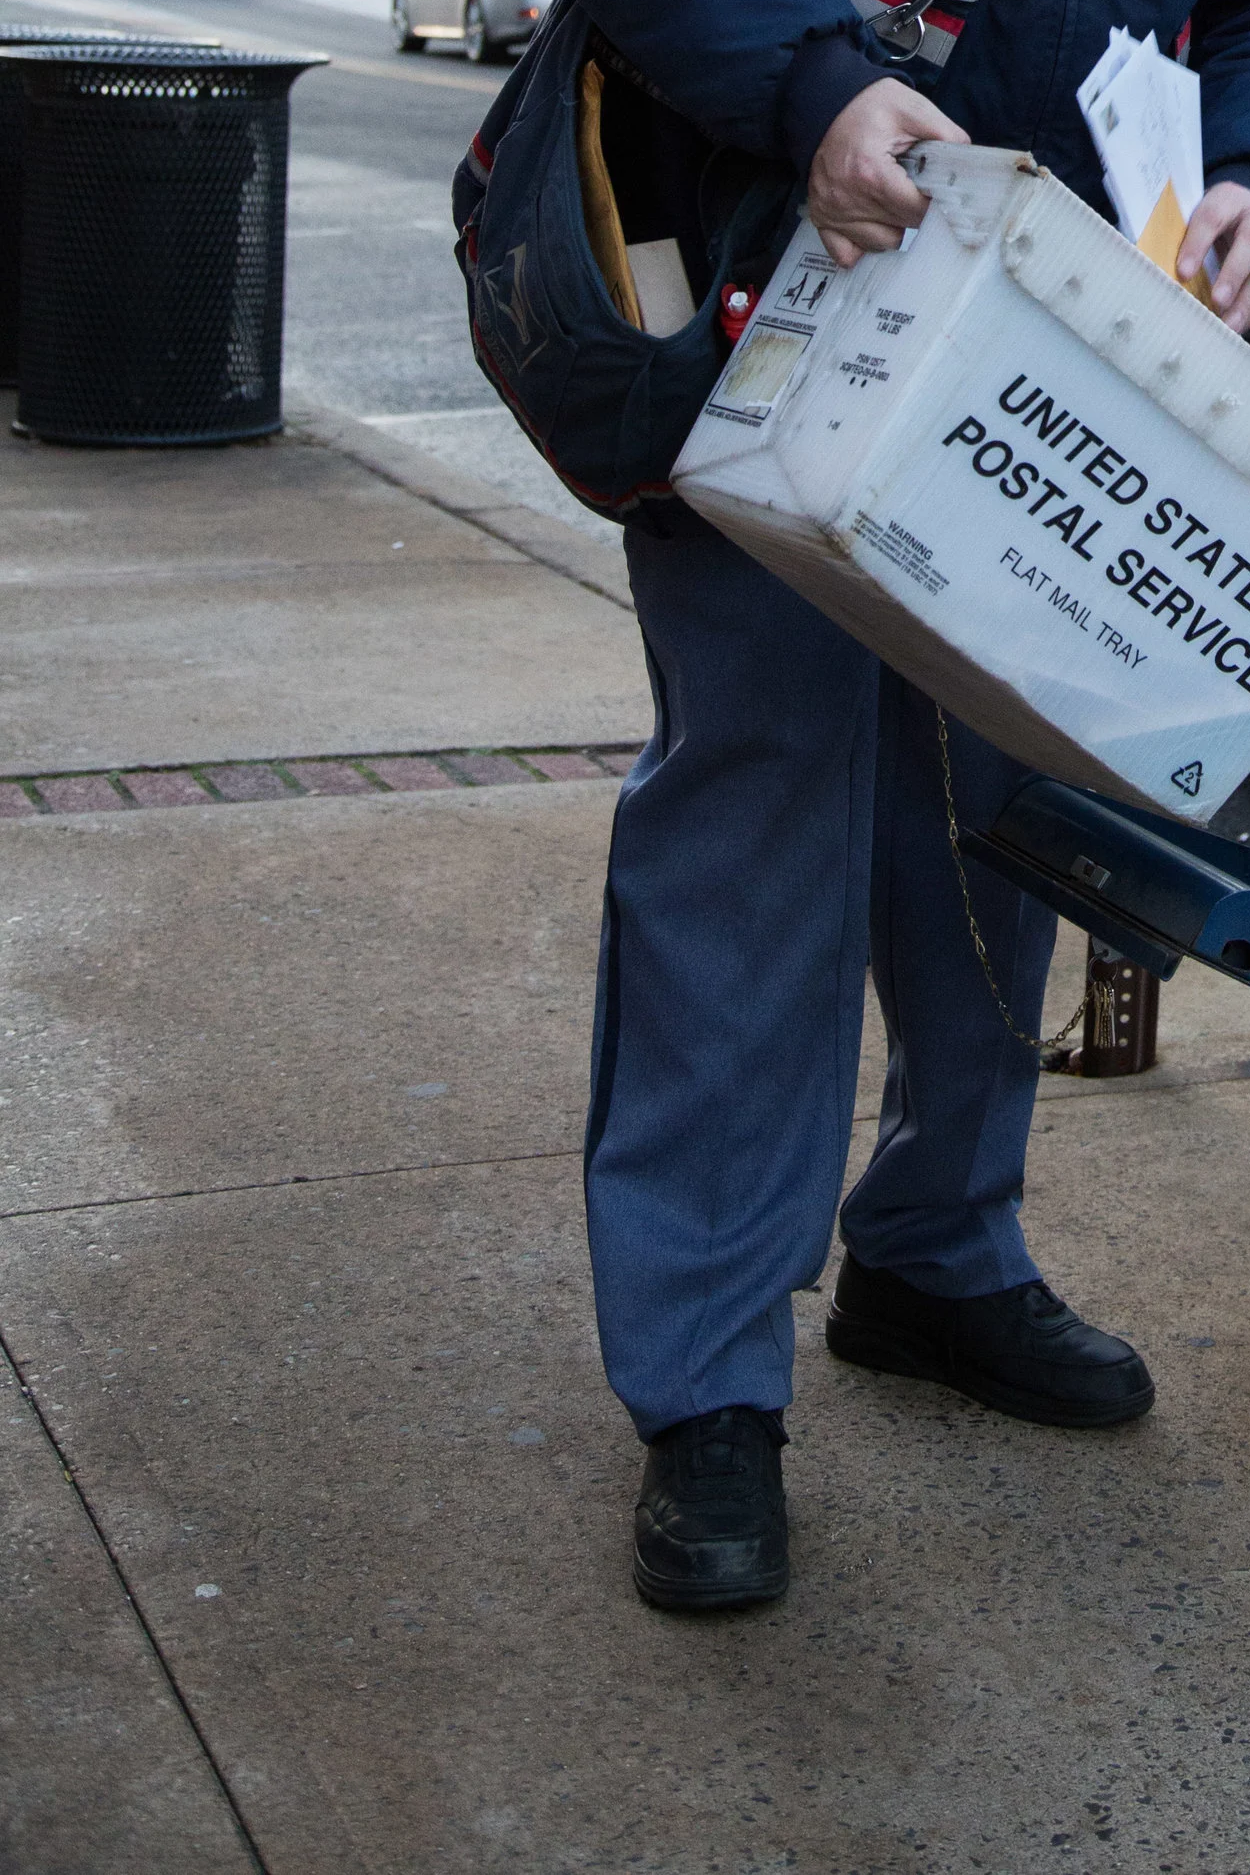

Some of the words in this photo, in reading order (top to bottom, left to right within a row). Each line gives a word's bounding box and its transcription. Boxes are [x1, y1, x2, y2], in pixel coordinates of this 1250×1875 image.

[875, 308, 893, 321] TARE
[891, 312, 916, 325] WEIGHT
[888, 324, 902, 335] LBS
[998, 374, 1149, 507] UNITED
[942, 416, 1103, 562] POSTAL
[888, 520, 934, 560] WARNING
[904, 547, 912, 555] for
[912, 554, 924, 565] theft
[911, 572, 923, 583] USC
[1000, 547, 1051, 593] FLAT
[1048, 586, 1091, 632] MAIL
[1099, 621, 1148, 670] TRAY
